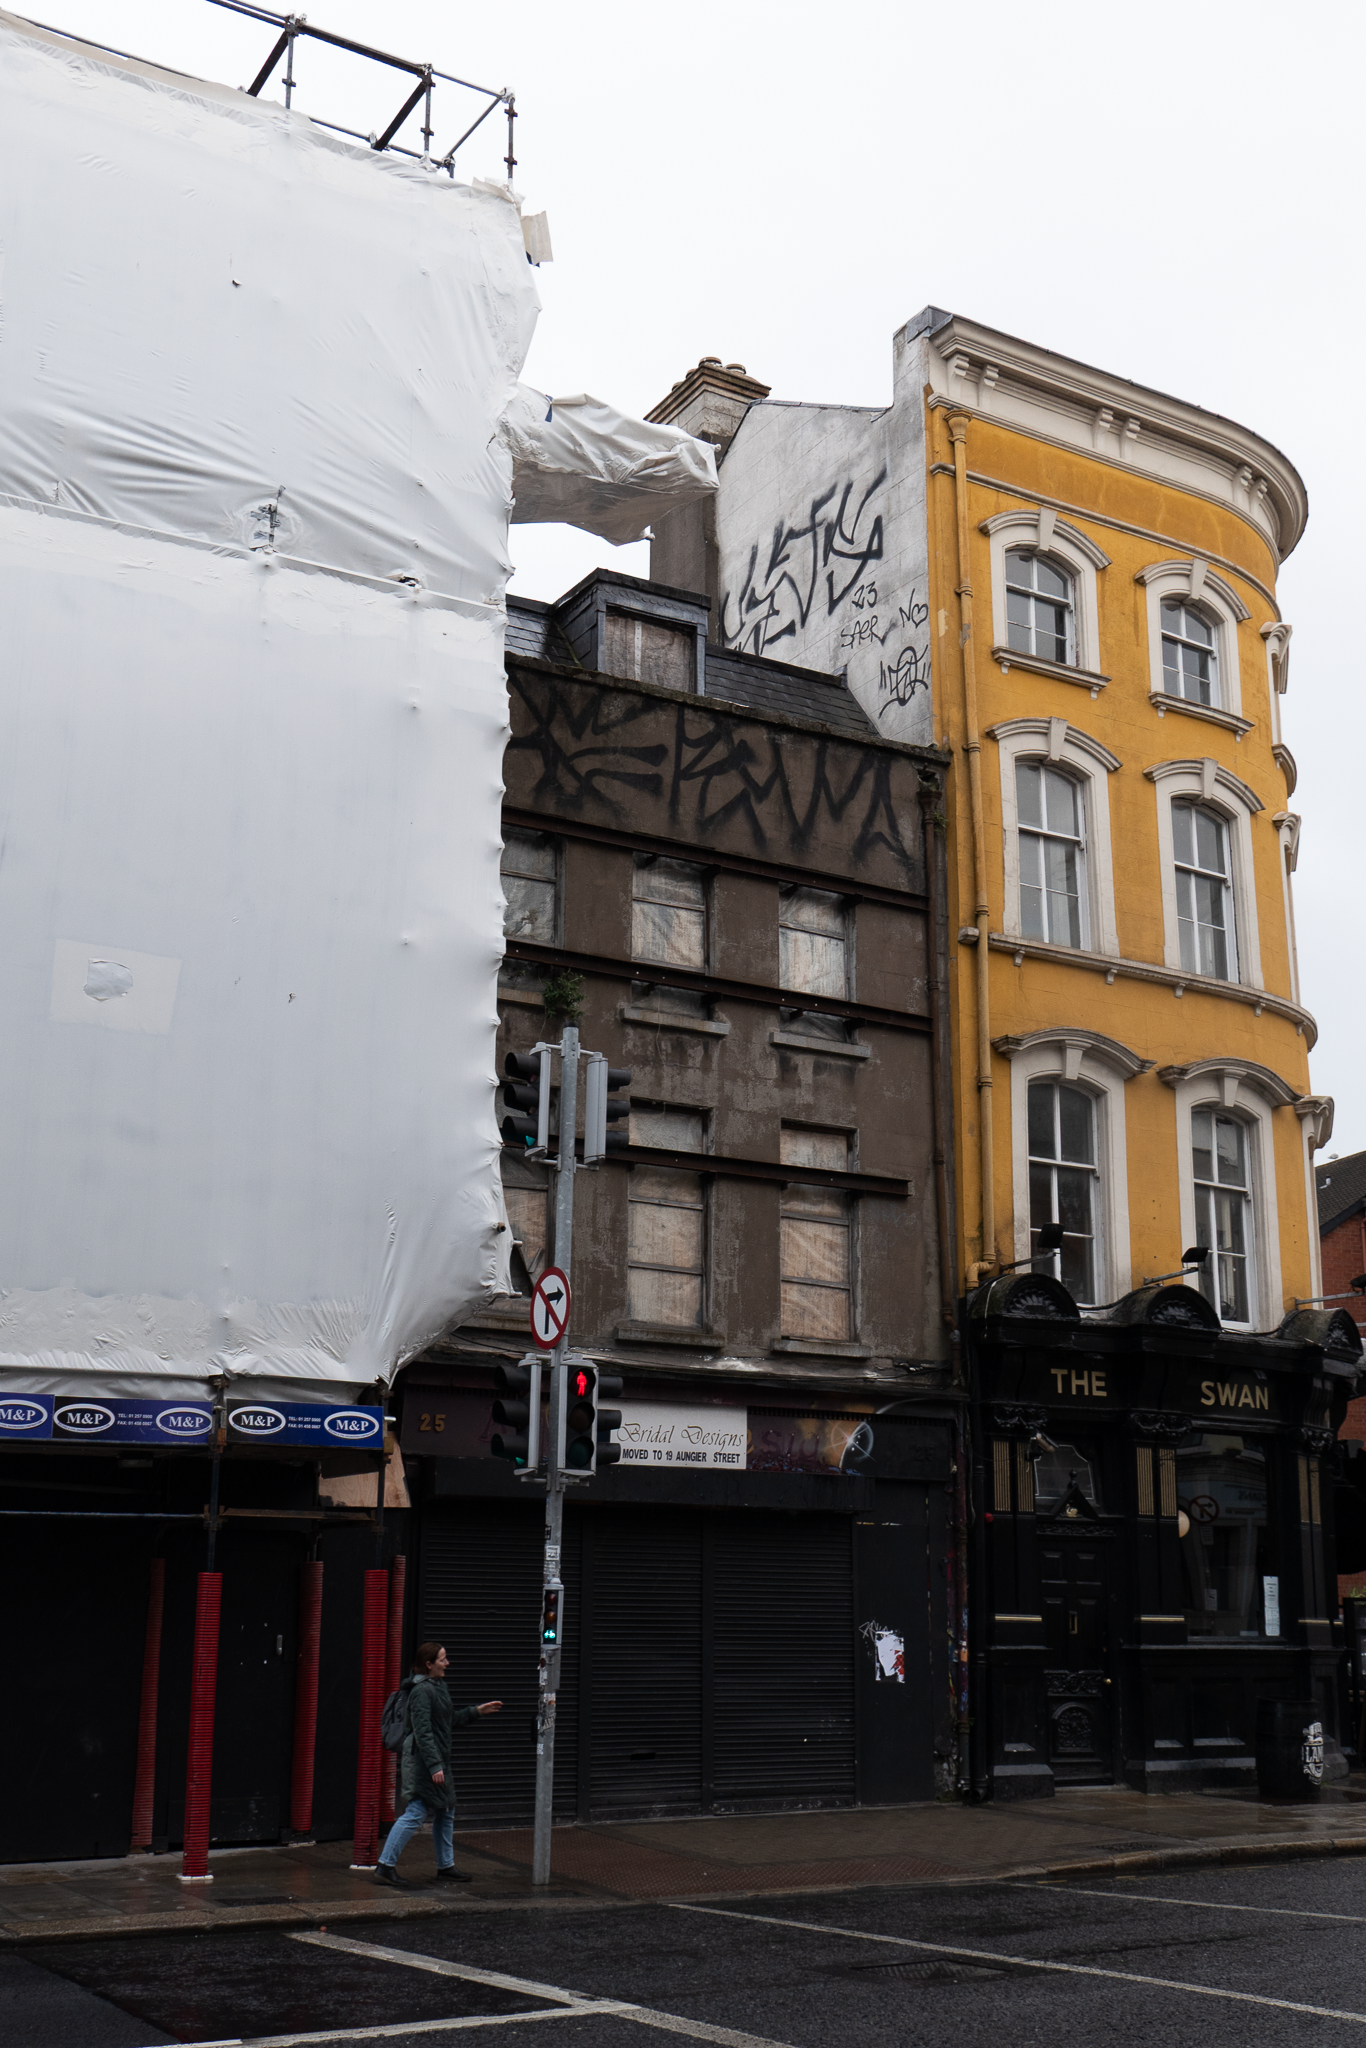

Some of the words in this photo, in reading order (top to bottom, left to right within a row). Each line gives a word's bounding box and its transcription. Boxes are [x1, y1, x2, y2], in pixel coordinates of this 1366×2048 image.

[1051, 1368, 1107, 1397] THE
[1201, 1381, 1269, 1410] SWAN
[0, 1408, 36, 1421] M&P
[66, 1412, 104, 1425] M&P
[241, 1415, 275, 1427] M&P
[169, 1416, 204, 1428] M&P
[336, 1419, 369, 1432] M&P
[419, 1413, 446, 1432] 25
[617, 1422, 675, 1444] Bridal
[681, 1425, 743, 1453] Designs
[622, 1449, 648, 1460] MOVED
[652, 1450, 662, 1460] TO
[665, 1451, 673, 1461] 19
[676, 1451, 707, 1463] AUNGIER
[713, 1452, 740, 1464] STREET
